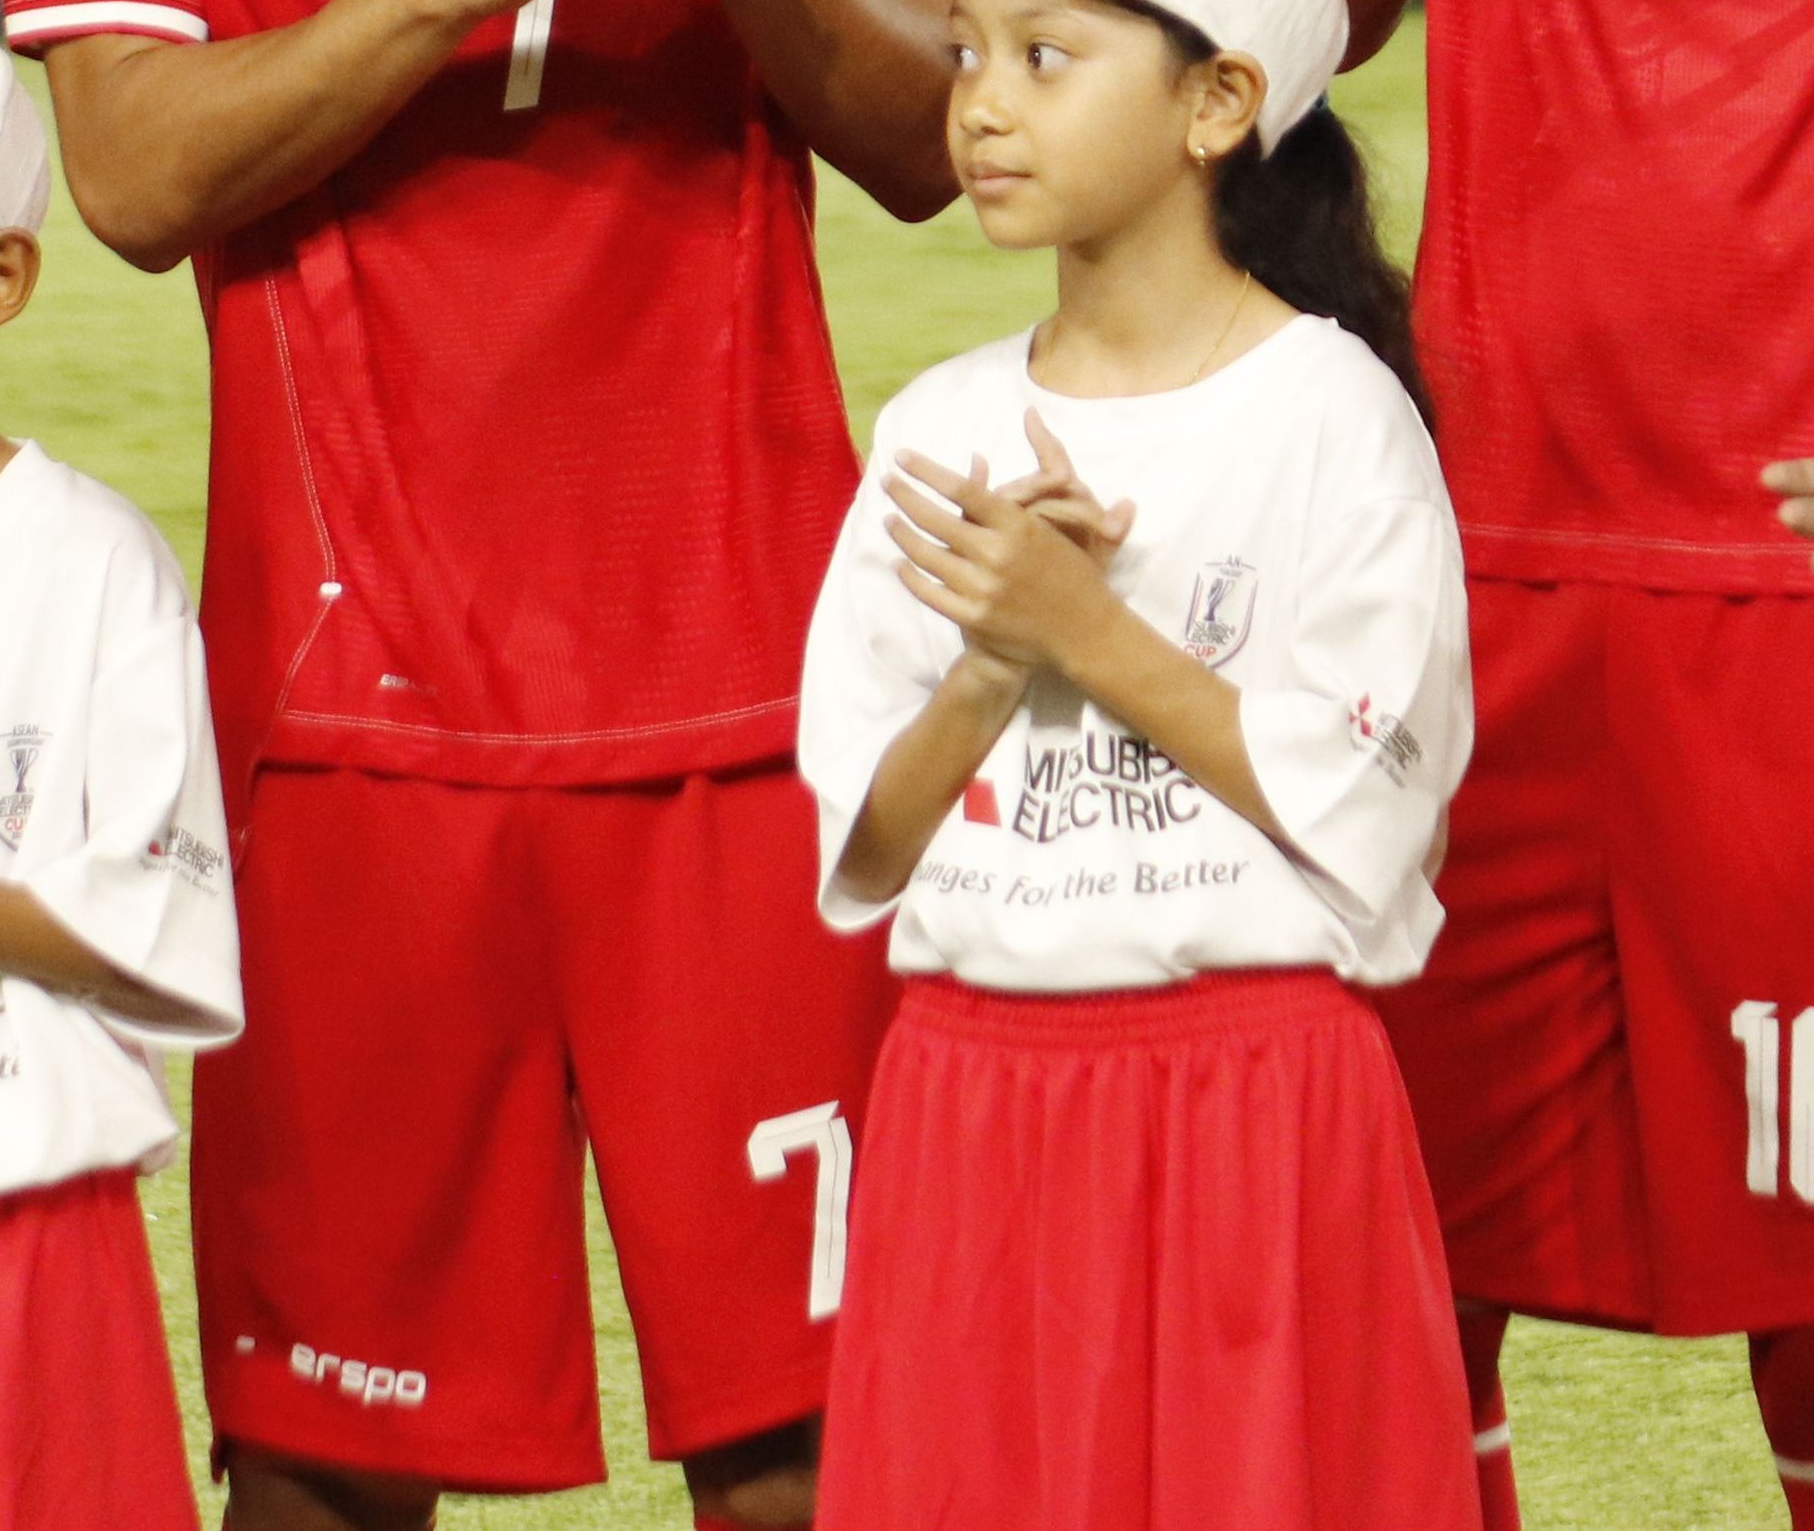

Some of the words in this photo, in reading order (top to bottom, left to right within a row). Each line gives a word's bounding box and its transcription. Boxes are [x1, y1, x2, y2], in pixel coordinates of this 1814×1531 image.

[1012, 777, 1202, 843] ELECTRIC
[1063, 867, 1118, 899] the
[1133, 858, 1251, 895] Better
[747, 1100, 854, 1322] 7
[290, 1341, 429, 1408] erspo
